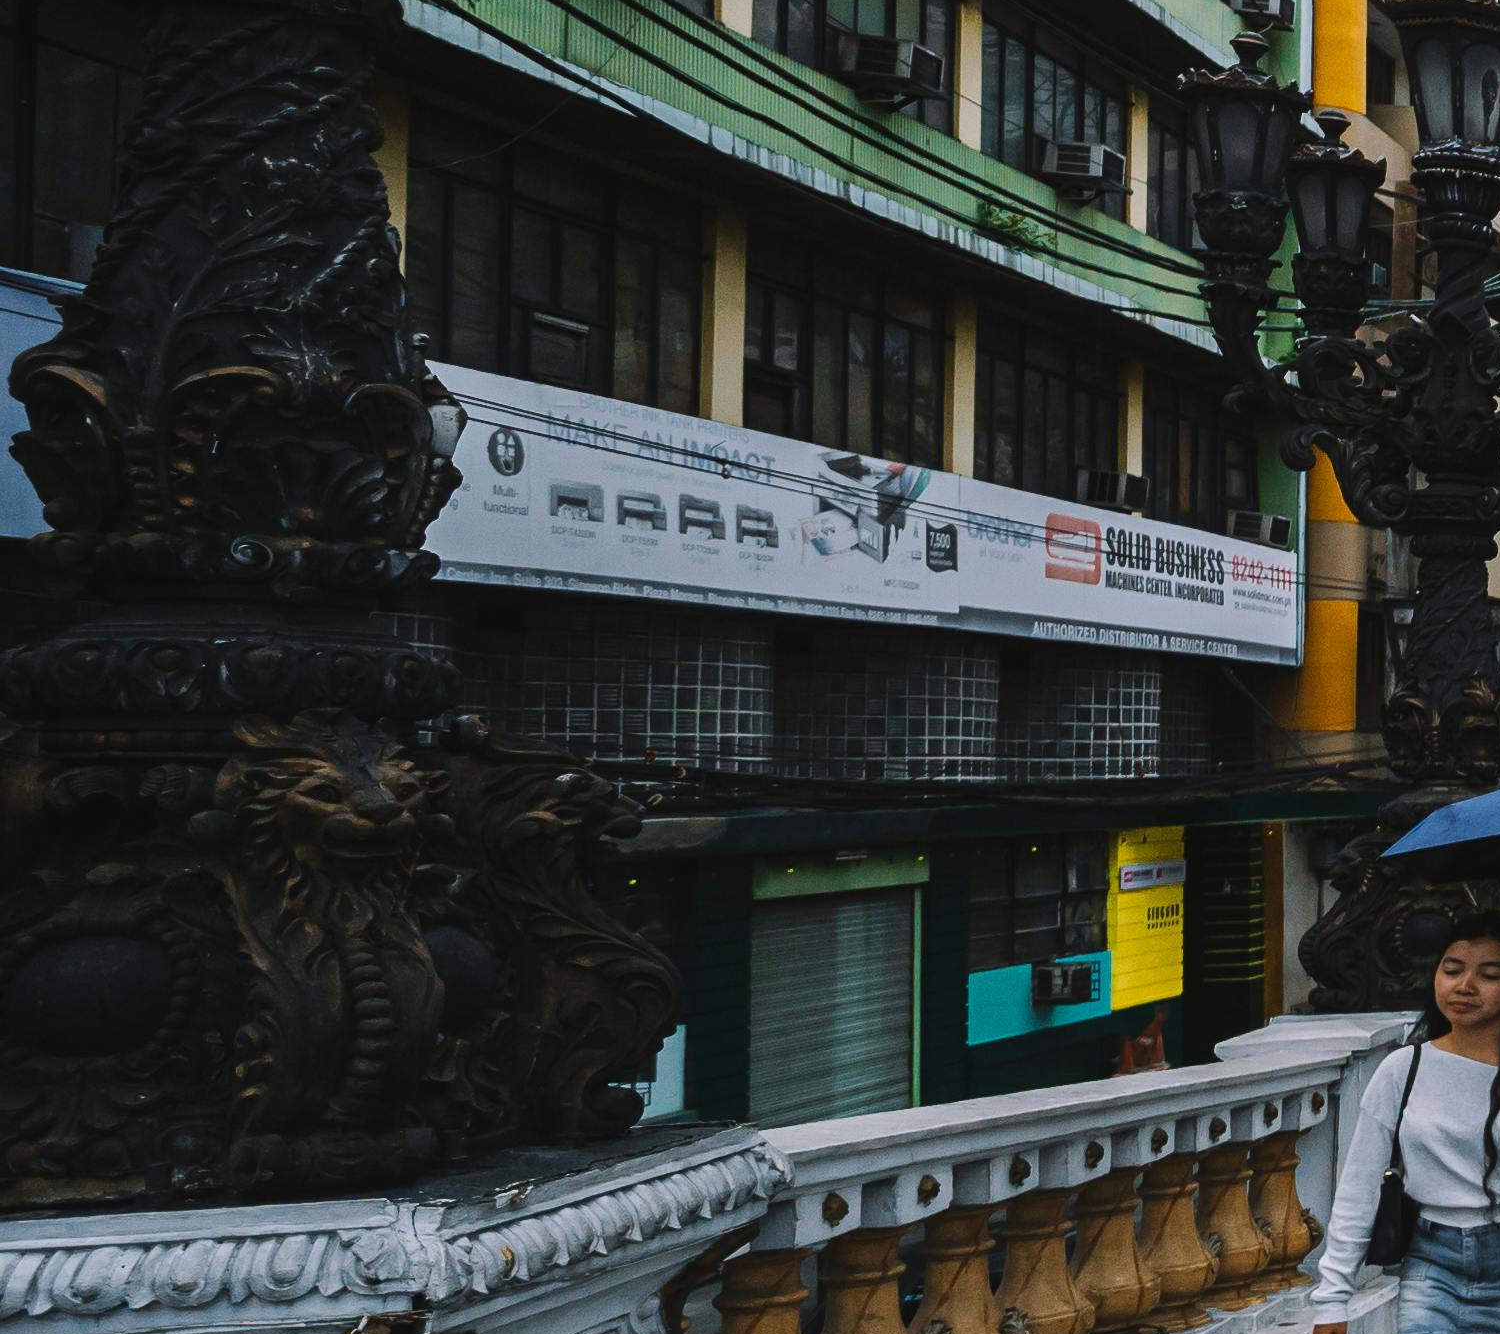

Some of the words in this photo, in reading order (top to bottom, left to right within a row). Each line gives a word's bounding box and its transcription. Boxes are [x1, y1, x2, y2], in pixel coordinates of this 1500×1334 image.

[1106, 526, 1151, 571] SOLID
[1156, 537, 1225, 585] BUSINESS
[1105, 571, 1144, 594] MACHINES
[1175, 581, 1225, 606] INCORPORATED
[1032, 621, 1096, 643] AUTHORIZED
[1099, 628, 1160, 649] DISTRIBUTOR
[1161, 635, 1168, 649] &
[1170, 636, 1205, 653] SERVICE
[1207, 641, 1238, 657] CENTER
